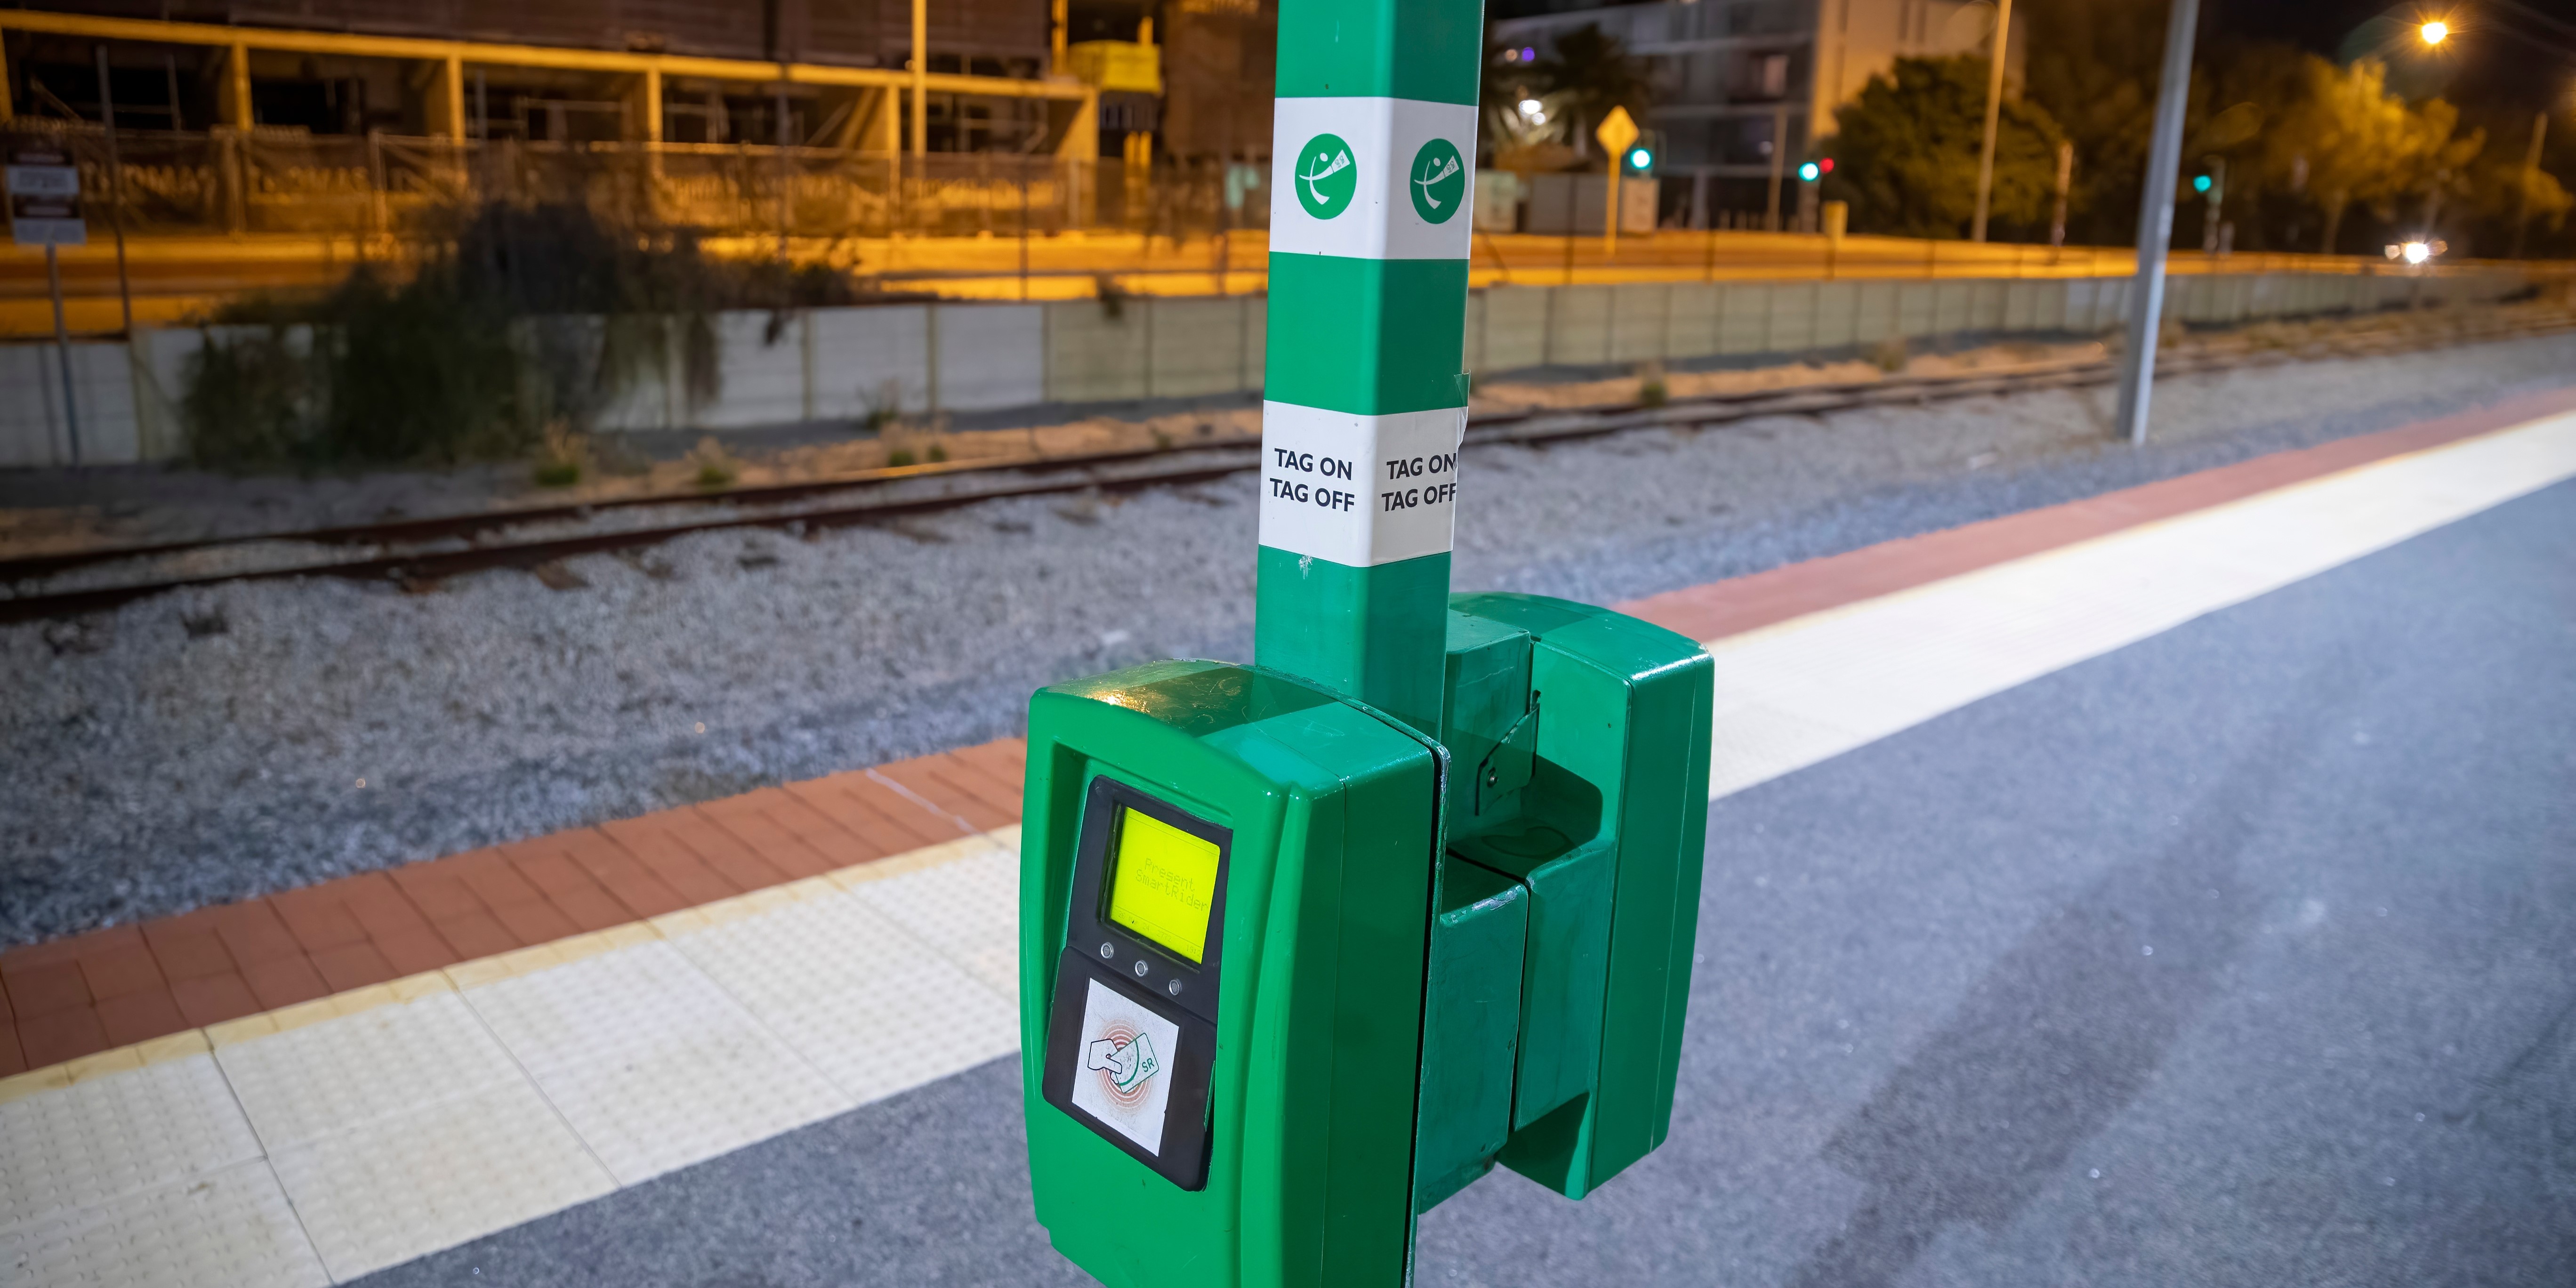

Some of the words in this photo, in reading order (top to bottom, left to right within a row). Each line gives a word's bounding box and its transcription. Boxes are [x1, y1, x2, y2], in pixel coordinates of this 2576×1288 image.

[1274, 448, 1313, 472] TAG
[1320, 457, 1352, 480] ON
[1386, 457, 1423, 479] TAG
[1429, 453, 1457, 473] ON
[1270, 478, 1308, 502] TAG
[1315, 488, 1355, 512] OFF
[1381, 488, 1418, 512] TAG
[1424, 483, 1457, 505] OFF
[1135, 869, 1208, 911] SmartRider
[1145, 858, 1195, 892] Present
[1142, 1057, 1155, 1072] SR
